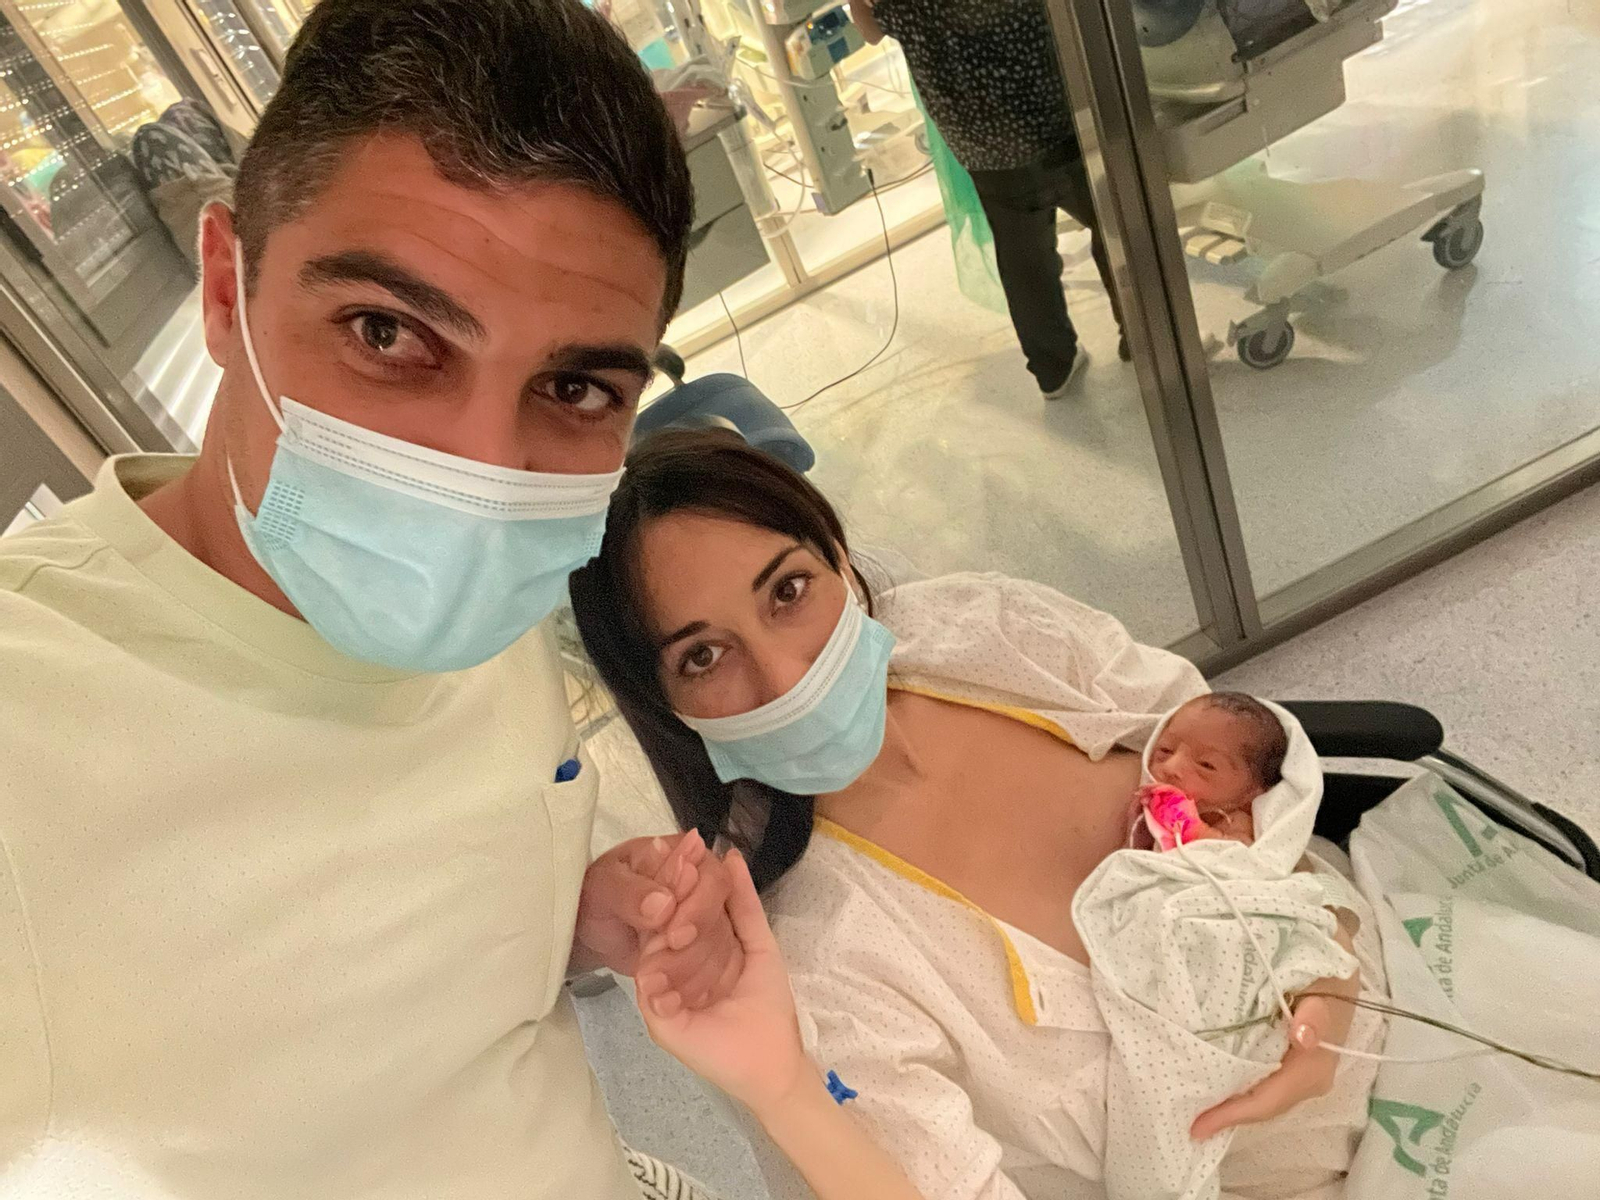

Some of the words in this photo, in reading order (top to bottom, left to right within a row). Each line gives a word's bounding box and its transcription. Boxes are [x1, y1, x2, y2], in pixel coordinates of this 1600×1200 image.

[1446, 860, 1486, 889] Junta
[1432, 956, 1453, 973] de
[1428, 1156, 1452, 1174] de
[1427, 1178, 1450, 1200] ta
